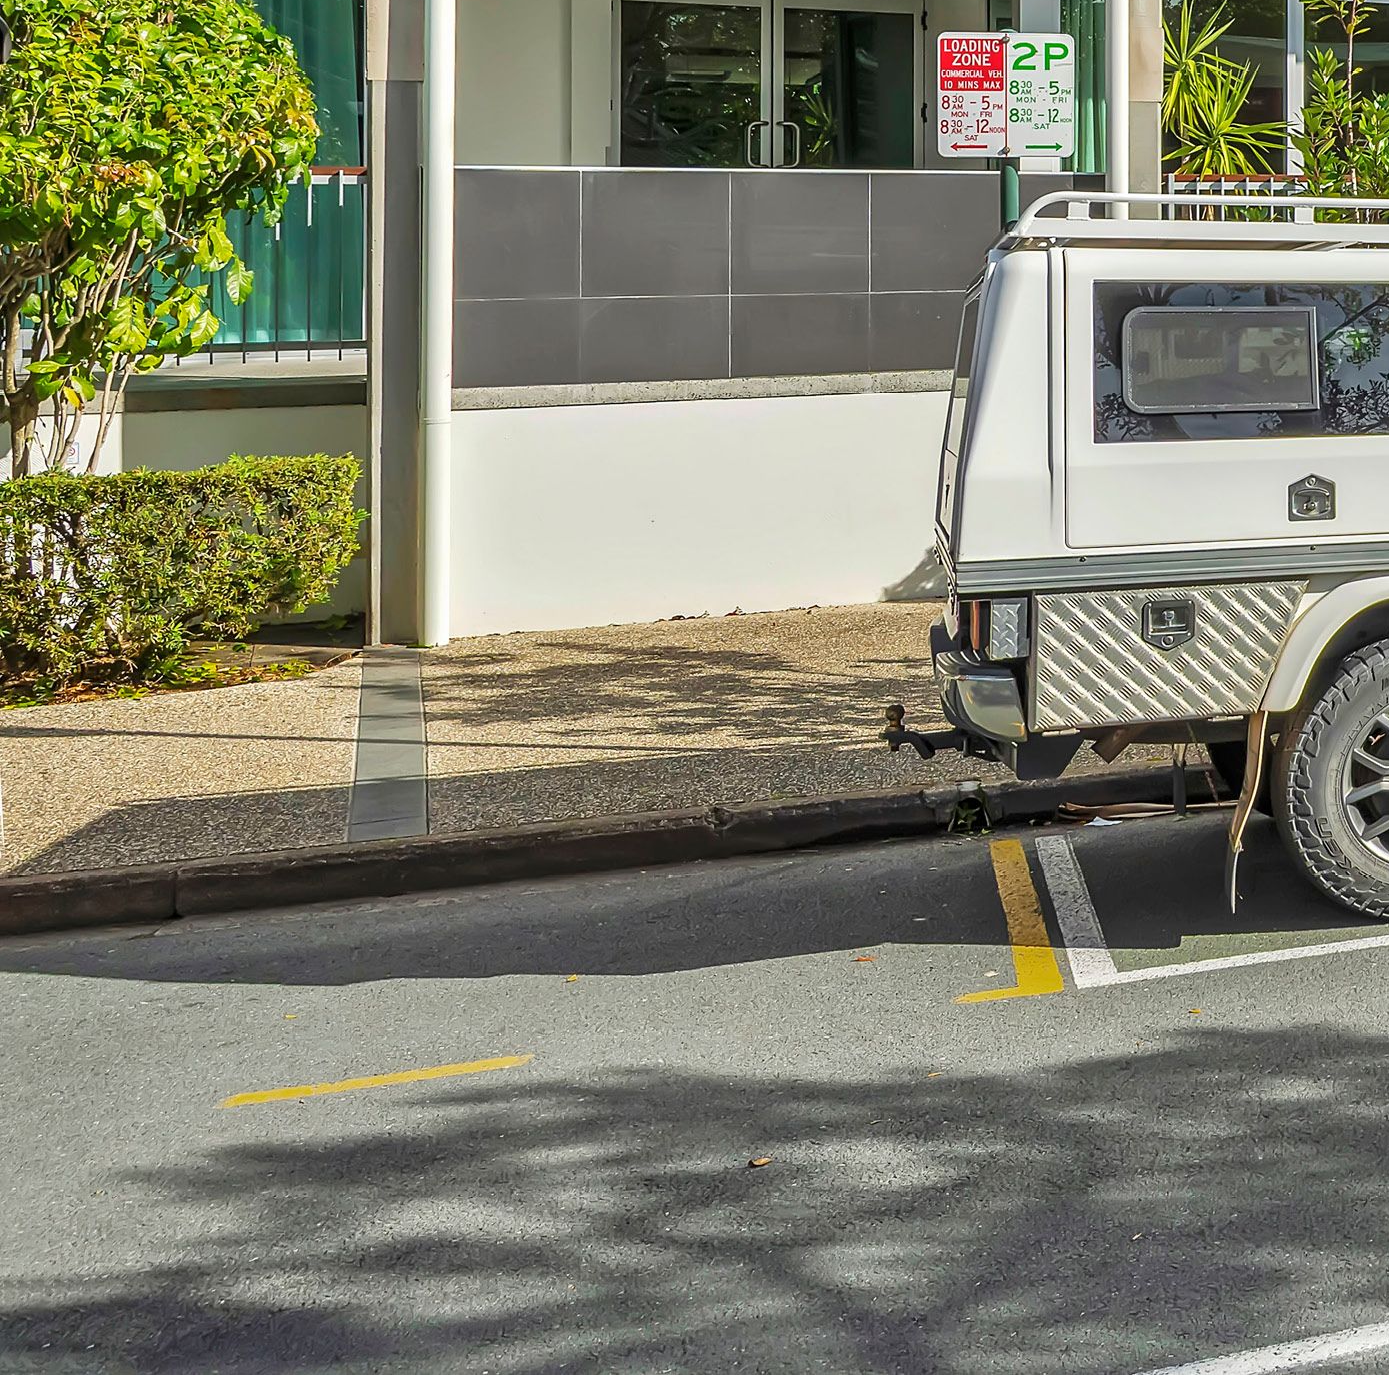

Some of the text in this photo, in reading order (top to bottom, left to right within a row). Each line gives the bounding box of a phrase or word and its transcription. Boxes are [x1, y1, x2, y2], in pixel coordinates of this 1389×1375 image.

[943, 39, 1000, 53] LOADING
[951, 53, 992, 67] ZONE
[1011, 42, 1069, 71] 2P
[941, 69, 985, 79] COMMERCIAL
[943, 80, 1001, 90] 10 MINS MAX
[1015, 96, 1037, 104] MON
[1051, 96, 1068, 104] FRI
